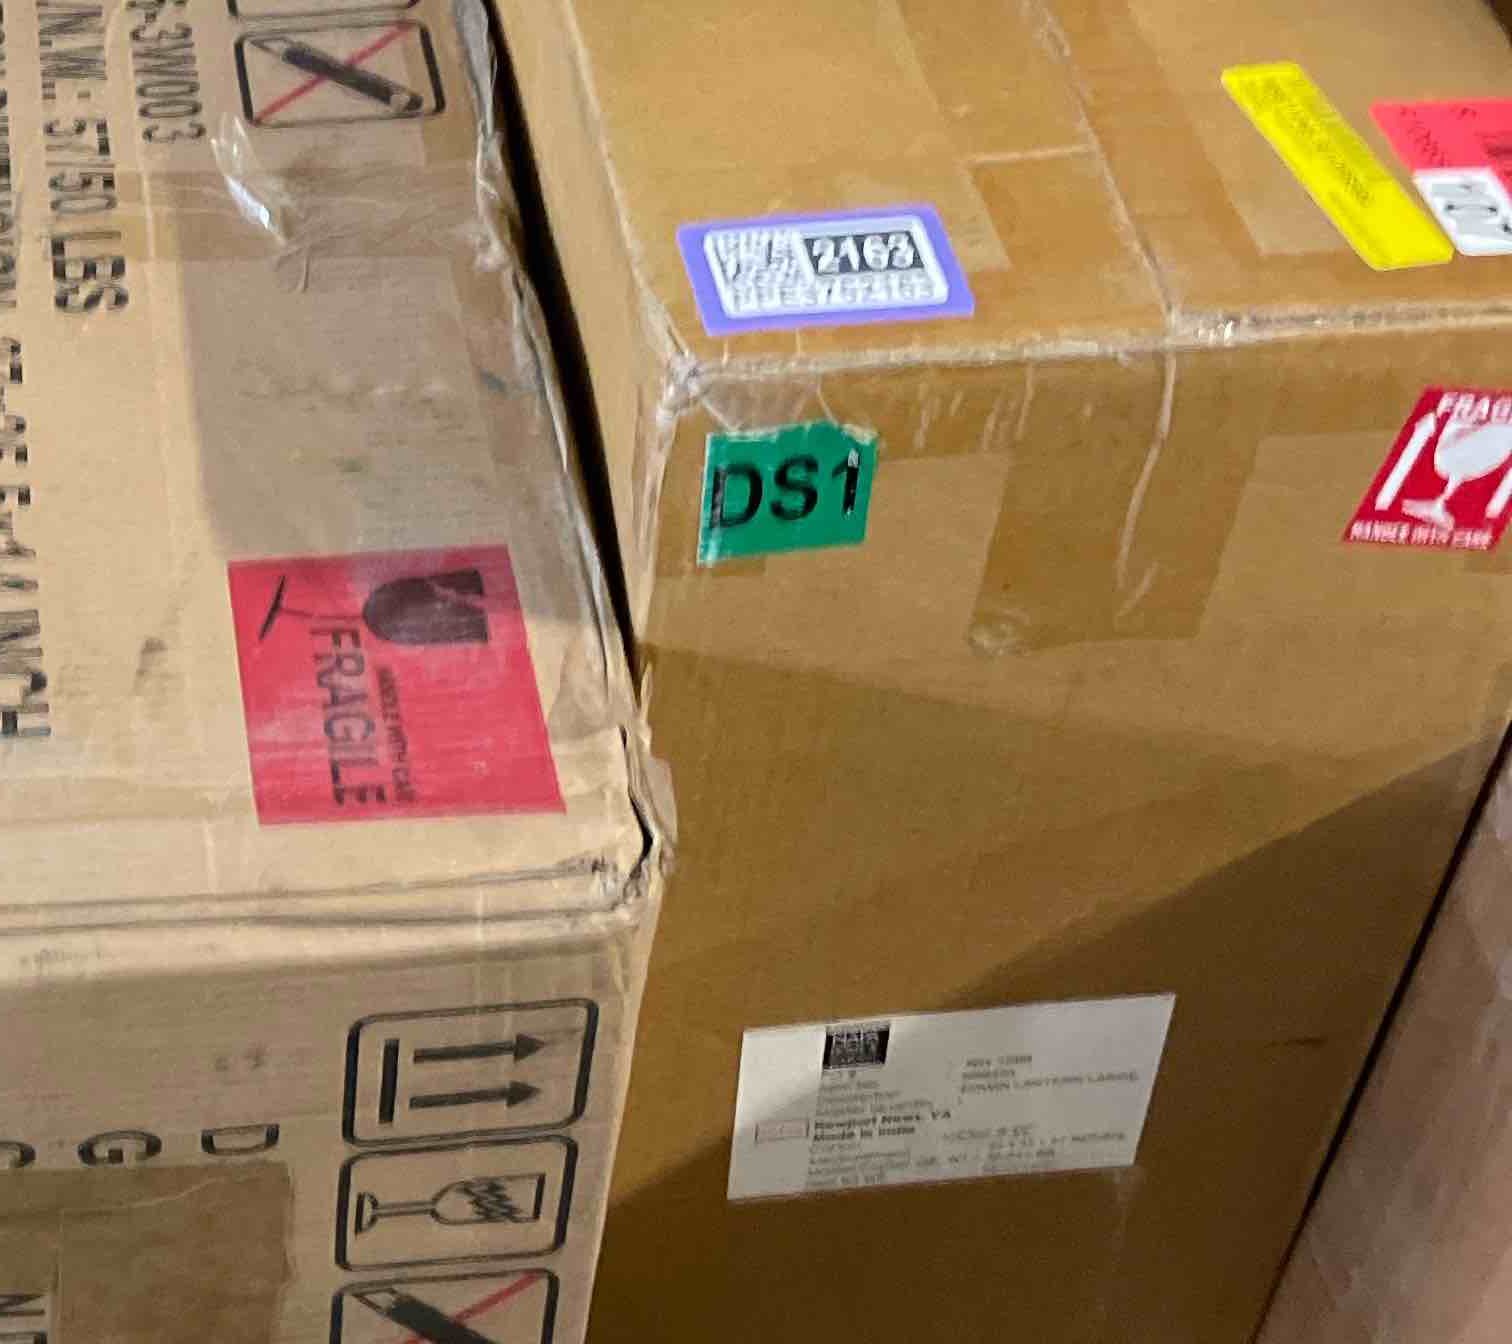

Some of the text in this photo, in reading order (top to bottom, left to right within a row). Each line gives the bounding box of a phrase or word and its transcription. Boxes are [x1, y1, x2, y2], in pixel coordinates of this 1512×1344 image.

[50, 230, 129, 313] LBS
[709, 449, 863, 531] DS1
[309, 627, 387, 806] FRAGILE
